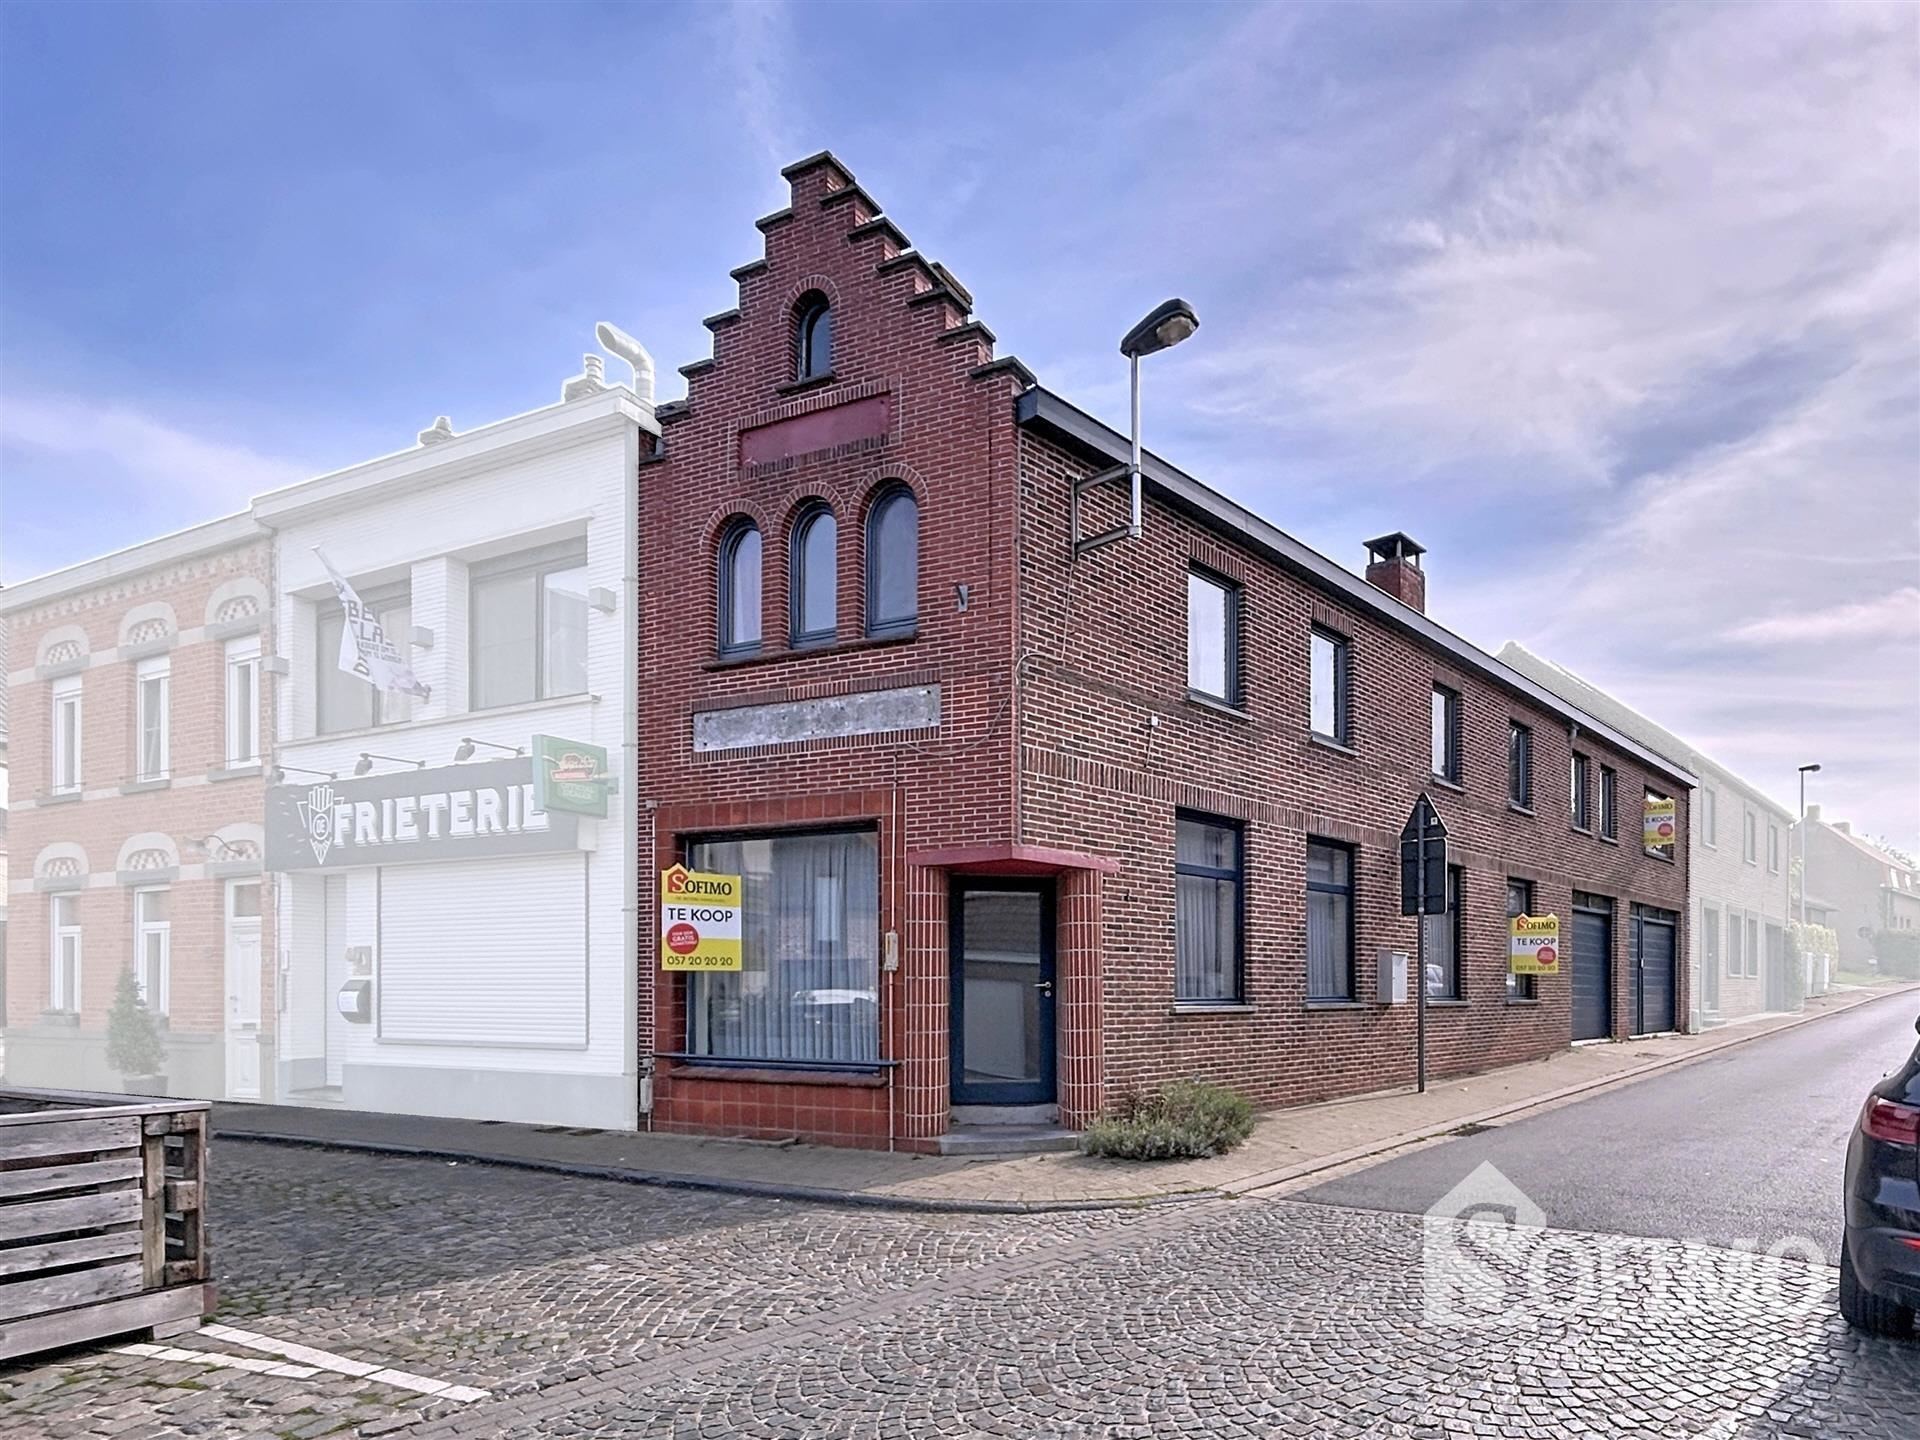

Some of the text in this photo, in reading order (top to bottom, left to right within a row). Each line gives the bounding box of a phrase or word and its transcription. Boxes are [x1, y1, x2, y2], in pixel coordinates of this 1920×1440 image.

[333, 784, 550, 848] FRIETERIE
[669, 872, 732, 895] SOFIMO
[668, 908, 733, 922] TE KOOP
[1518, 918, 1556, 930] SOFIMO
[667, 956, 733, 966] 057 20 20 20
